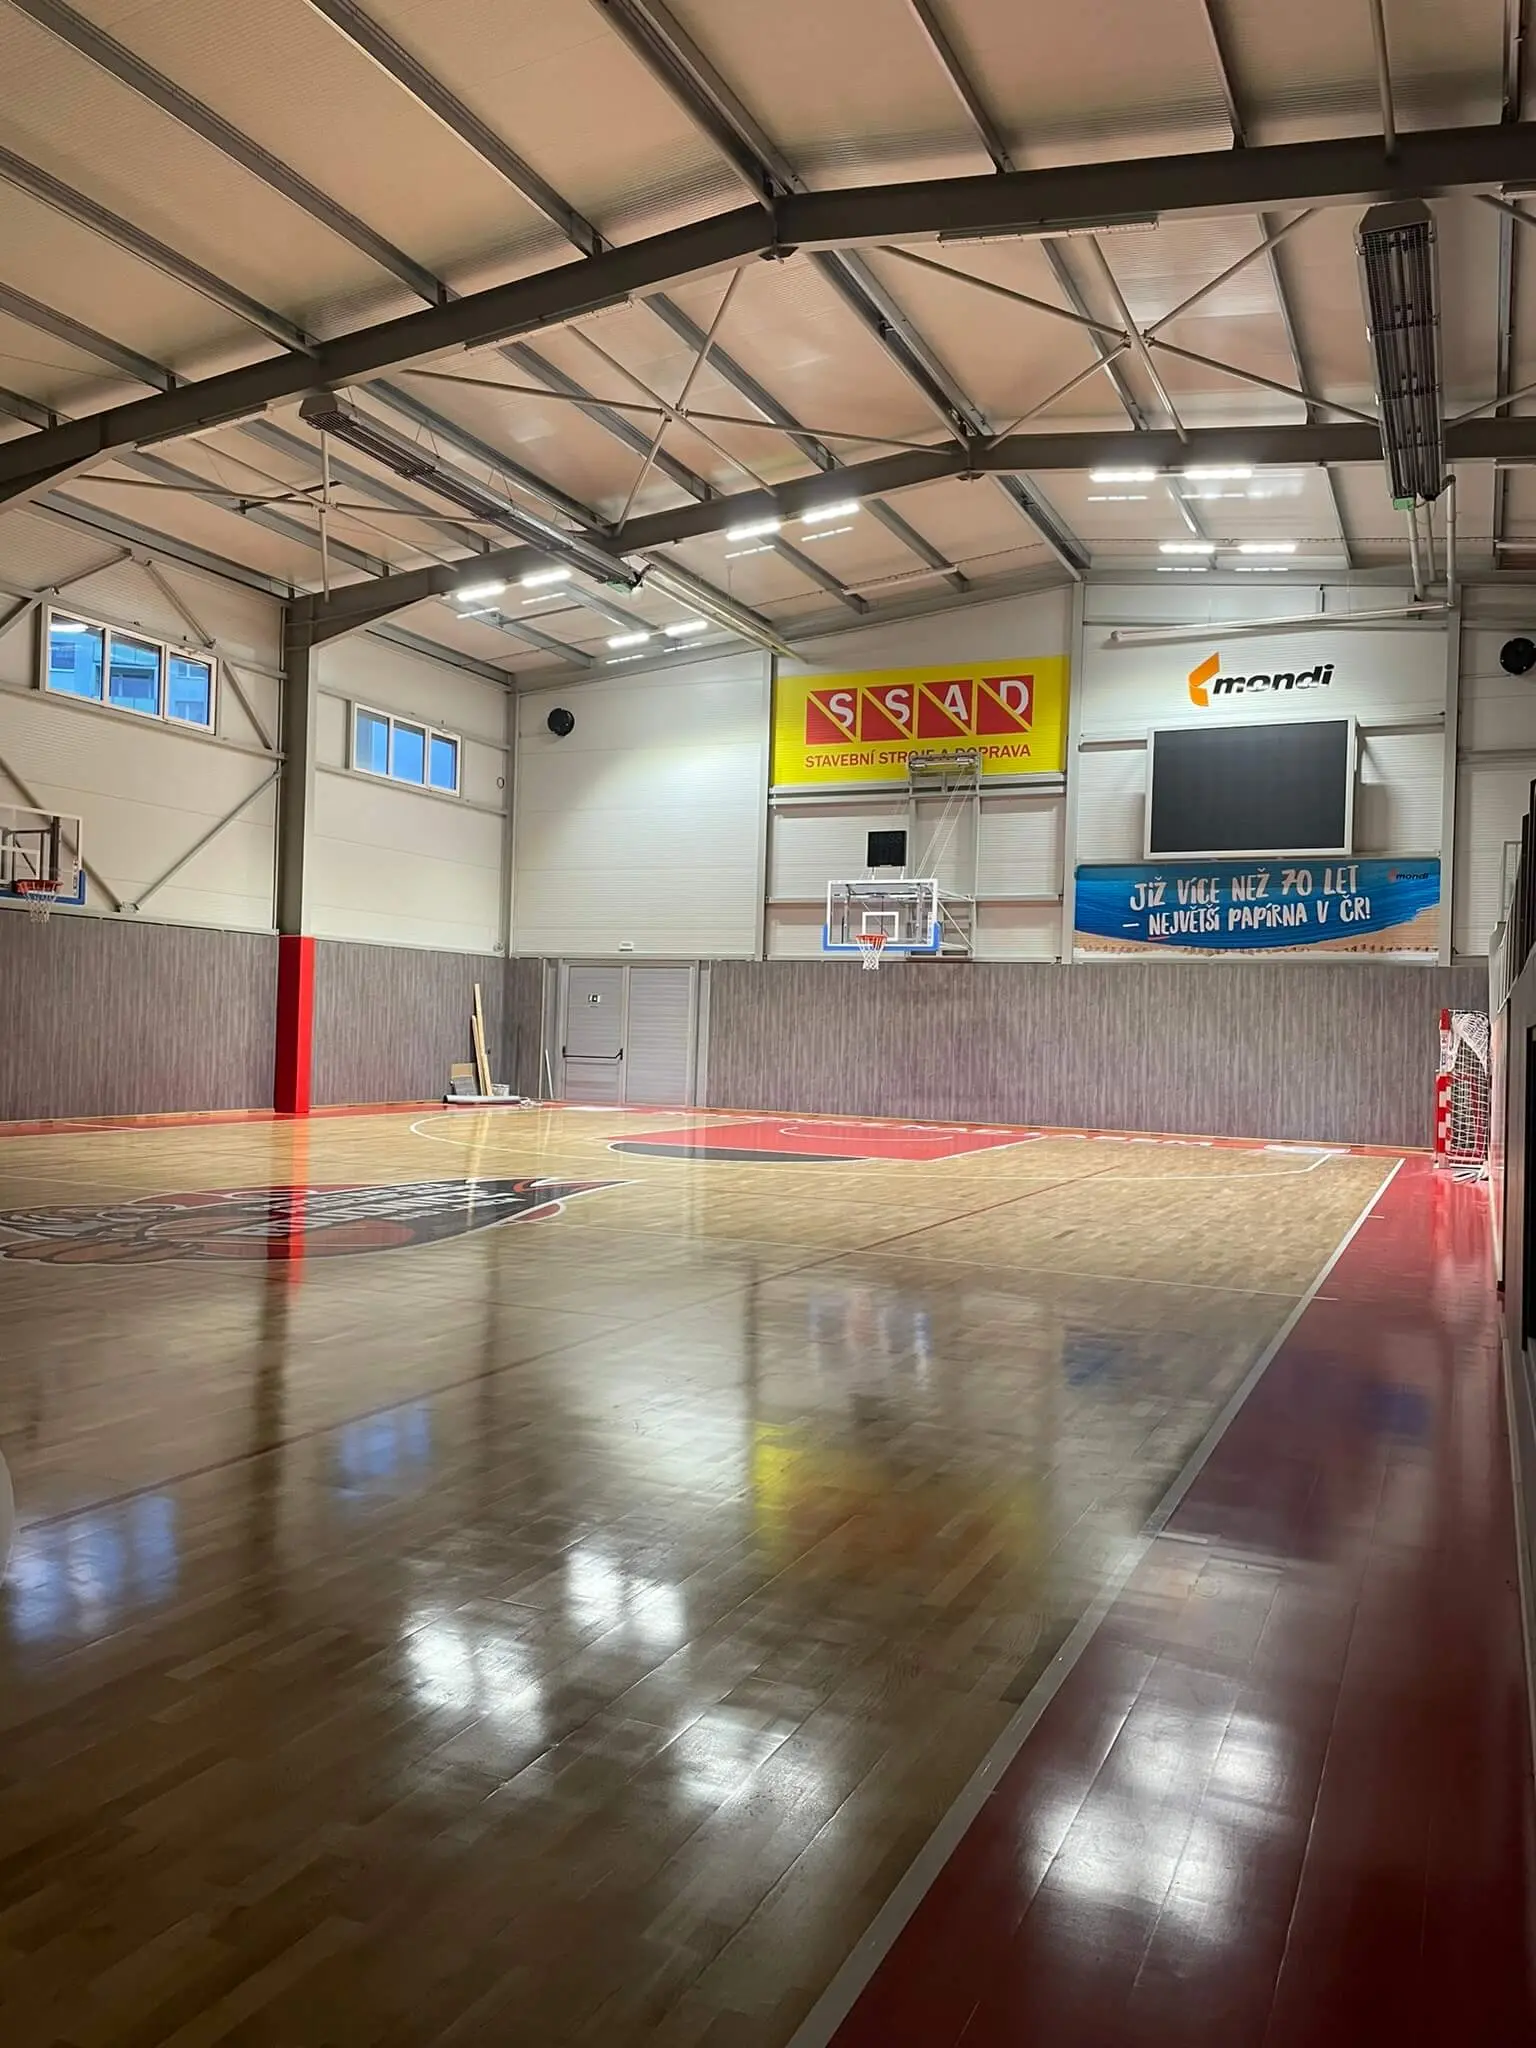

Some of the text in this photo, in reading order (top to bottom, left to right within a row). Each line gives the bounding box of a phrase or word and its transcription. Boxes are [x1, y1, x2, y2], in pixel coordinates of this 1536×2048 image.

[1213, 664, 1335, 695] mondi
[828, 679, 1030, 728] SSAD
[805, 749, 875, 768] STAVEBNÍ
[1177, 877, 1220, 905] VÍCE
[1232, 868, 1269, 902] NEŽ
[1281, 868, 1313, 896] 70
[1324, 864, 1360, 895] LET
[1396, 872, 1429, 880] mondi
[1149, 904, 1220, 936] NEJVĚTŠÍ
[1228, 902, 1308, 931] PAPÍRNA
[1316, 899, 1330, 924] V
[1340, 895, 1371, 922] ČR!
